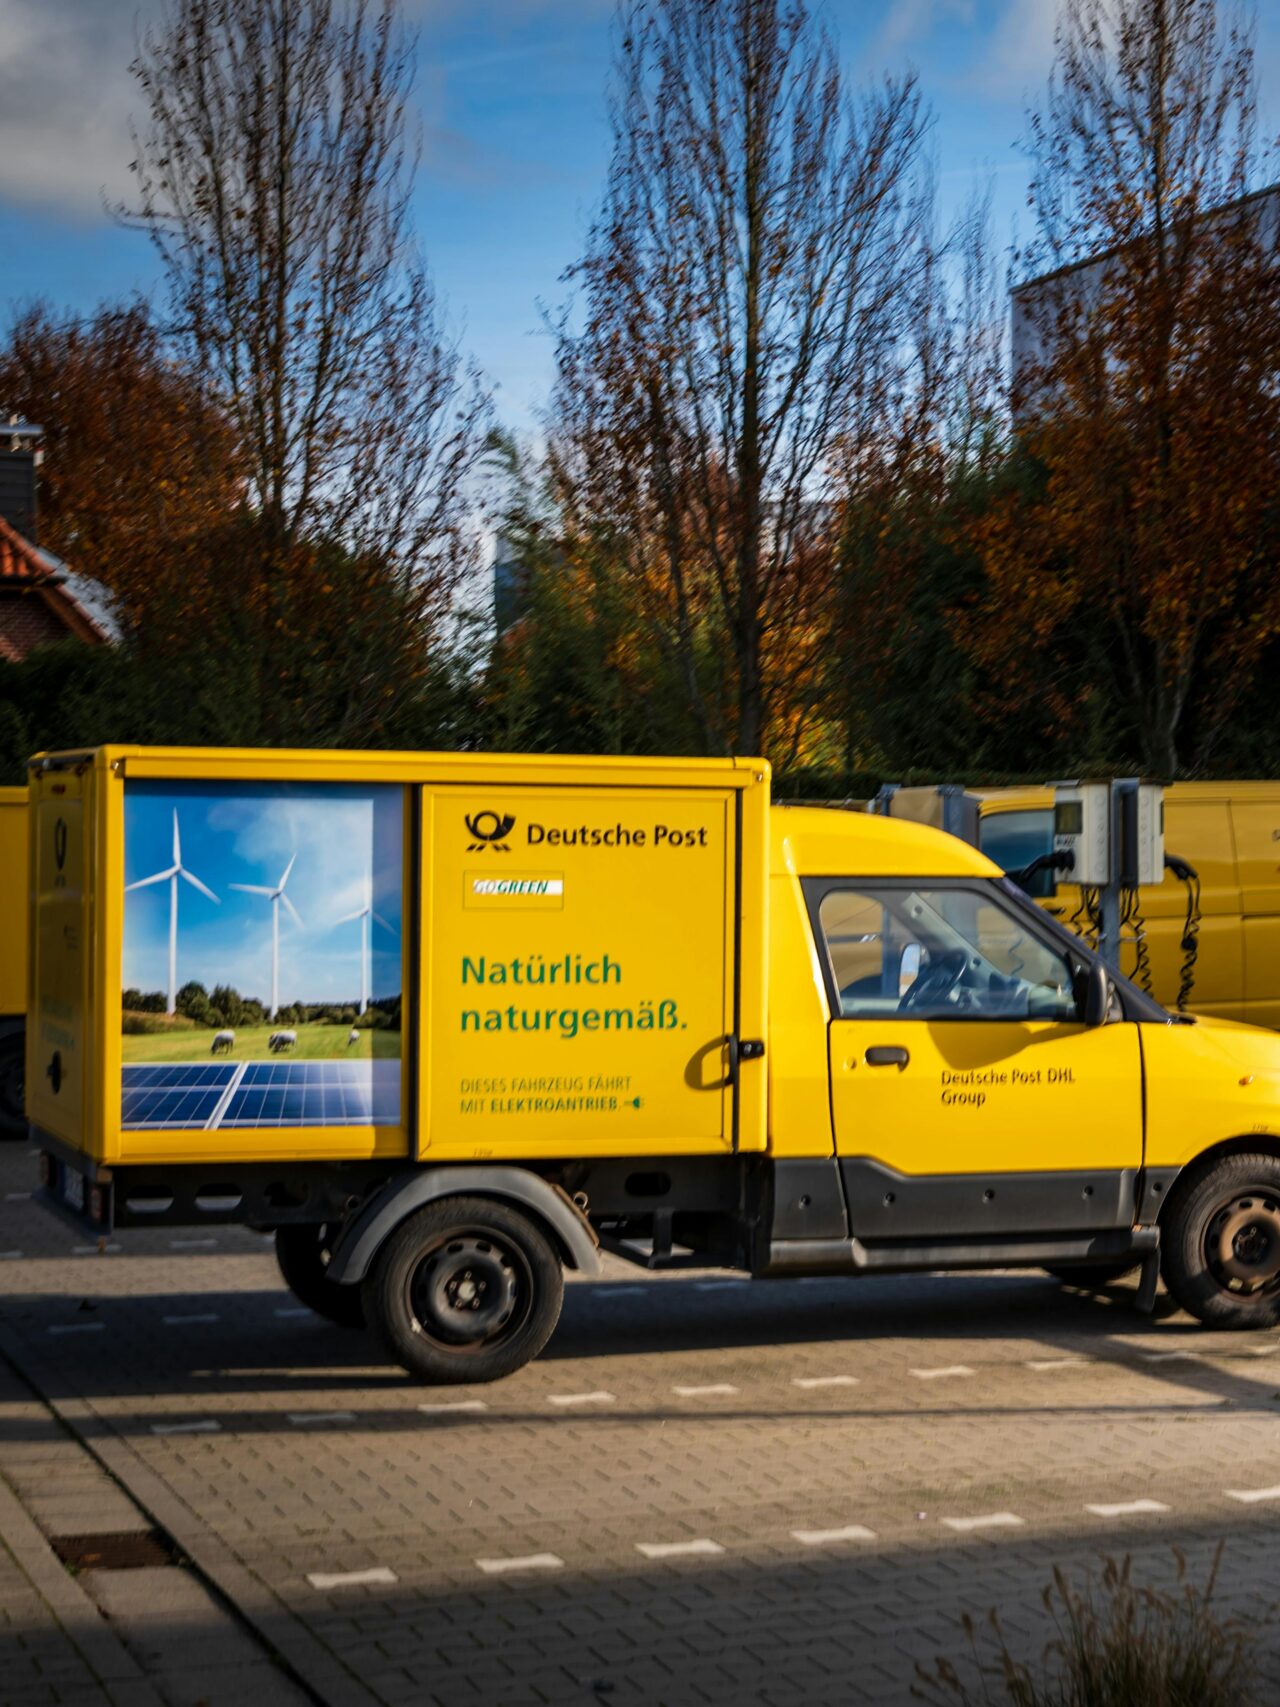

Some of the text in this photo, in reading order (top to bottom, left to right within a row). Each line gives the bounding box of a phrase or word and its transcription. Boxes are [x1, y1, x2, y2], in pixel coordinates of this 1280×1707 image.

[527, 823, 708, 847] Deutsche Post
[461, 953, 622, 984] Natürlich
[460, 999, 688, 1039] naturgemäß.
[460, 1073, 633, 1094] DIESES FAHRZEUG FÄHRT
[941, 1067, 1077, 1085] Deutsche Post DHL
[460, 1096, 622, 1114] MIT ELEKTROANTRIEB.
[941, 1089, 986, 1109] Group
